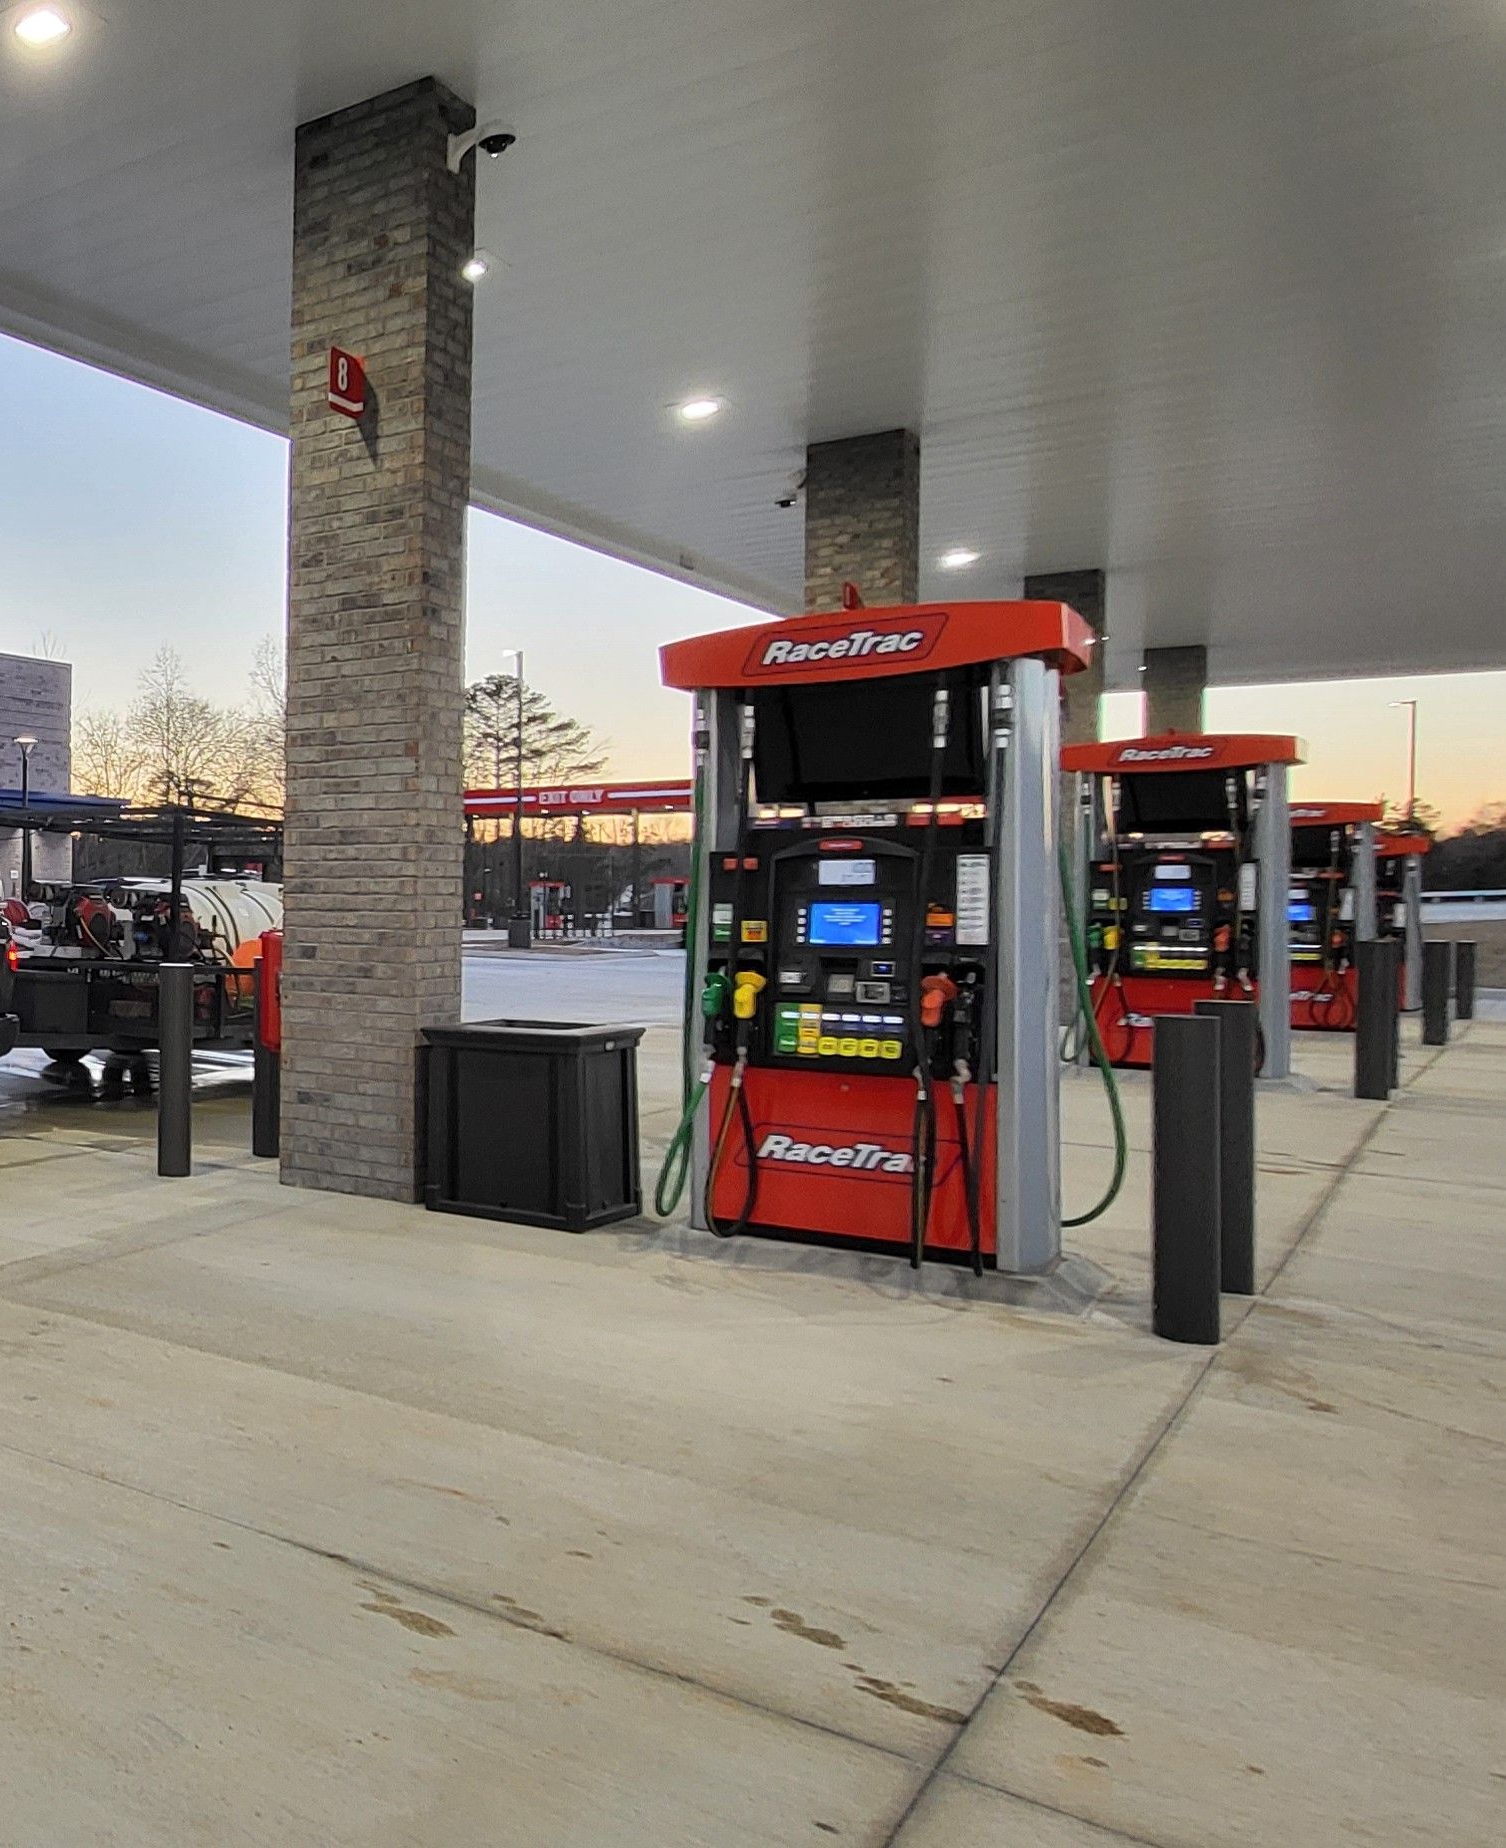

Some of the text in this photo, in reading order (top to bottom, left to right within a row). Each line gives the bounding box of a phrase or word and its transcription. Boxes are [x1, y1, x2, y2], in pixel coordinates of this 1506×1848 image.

[338, 357, 348, 391] 8
[761, 631, 925, 666] RaceTrac
[756, 1134, 916, 1173] RaceTra
